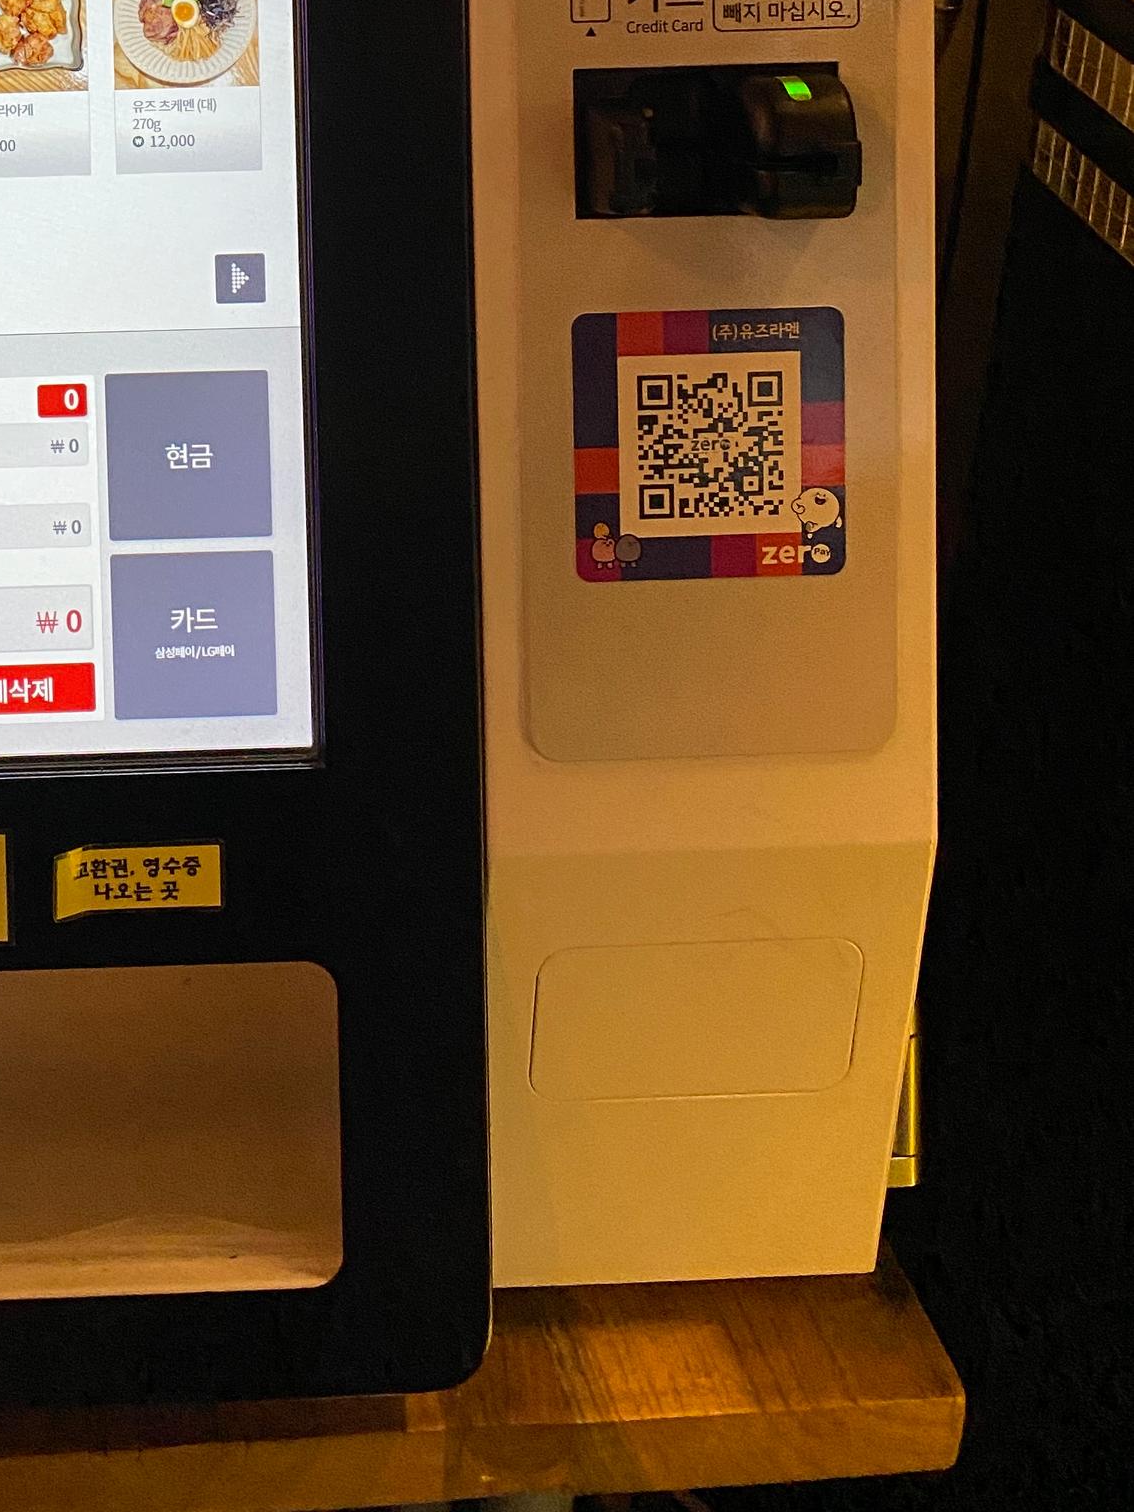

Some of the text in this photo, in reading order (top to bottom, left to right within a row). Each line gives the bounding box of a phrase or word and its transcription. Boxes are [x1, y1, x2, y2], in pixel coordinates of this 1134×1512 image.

[626, 0, 851, 34] Credit Card 빼지 마십시오.
[132, 97, 195, 114] 유즈 츠케멘
[132, 116, 161, 132] 270g
[149, 133, 195, 150] 12,000
[712, 321, 800, 341] (주)유즈라멘
[63, 388, 79, 409] 0
[165, 443, 214, 470] 현금
[170, 607, 218, 634] 카드
[141, 856, 202, 878] 영수증
[93, 881, 181, 902] 나오는 곳
